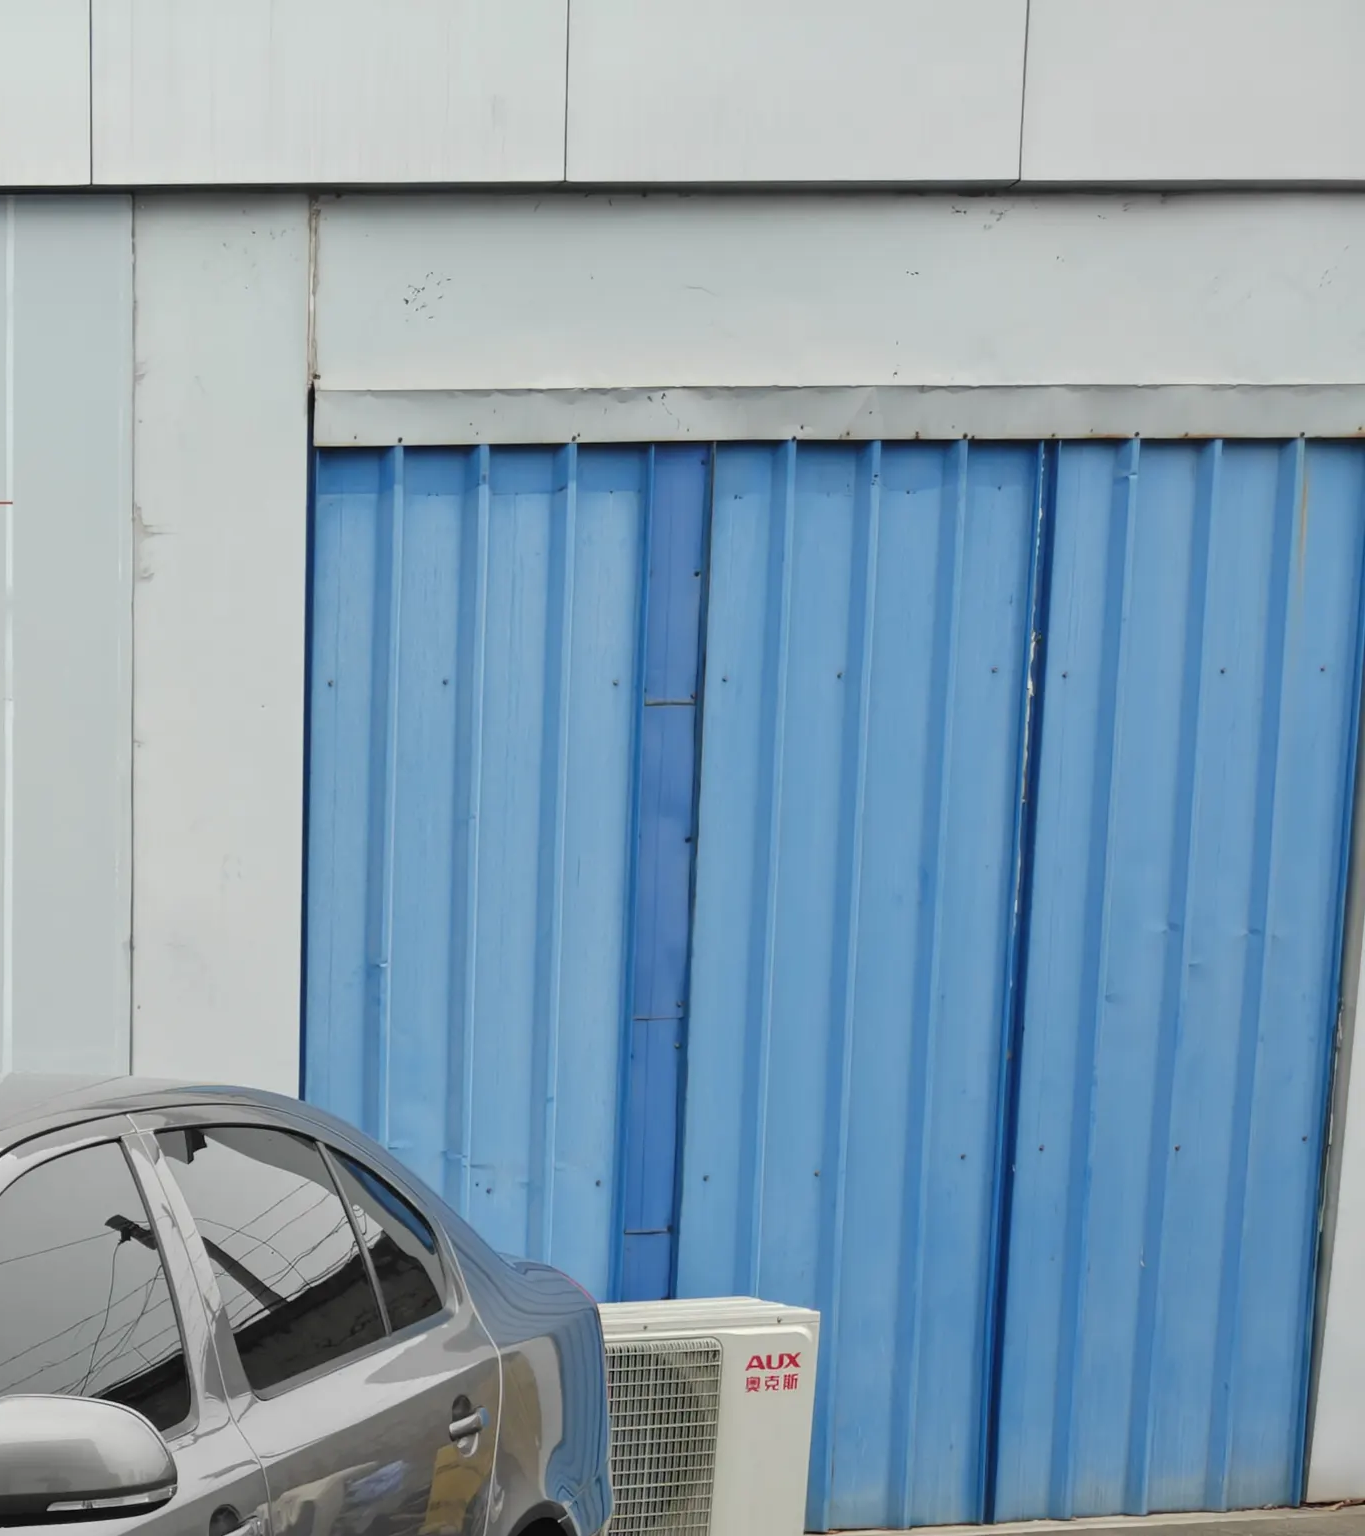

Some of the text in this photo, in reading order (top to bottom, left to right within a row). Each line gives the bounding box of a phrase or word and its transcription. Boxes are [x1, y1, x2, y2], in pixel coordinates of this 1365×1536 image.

[744, 1351, 802, 1372] AUX
[744, 1372, 801, 1393] 奥克斯
